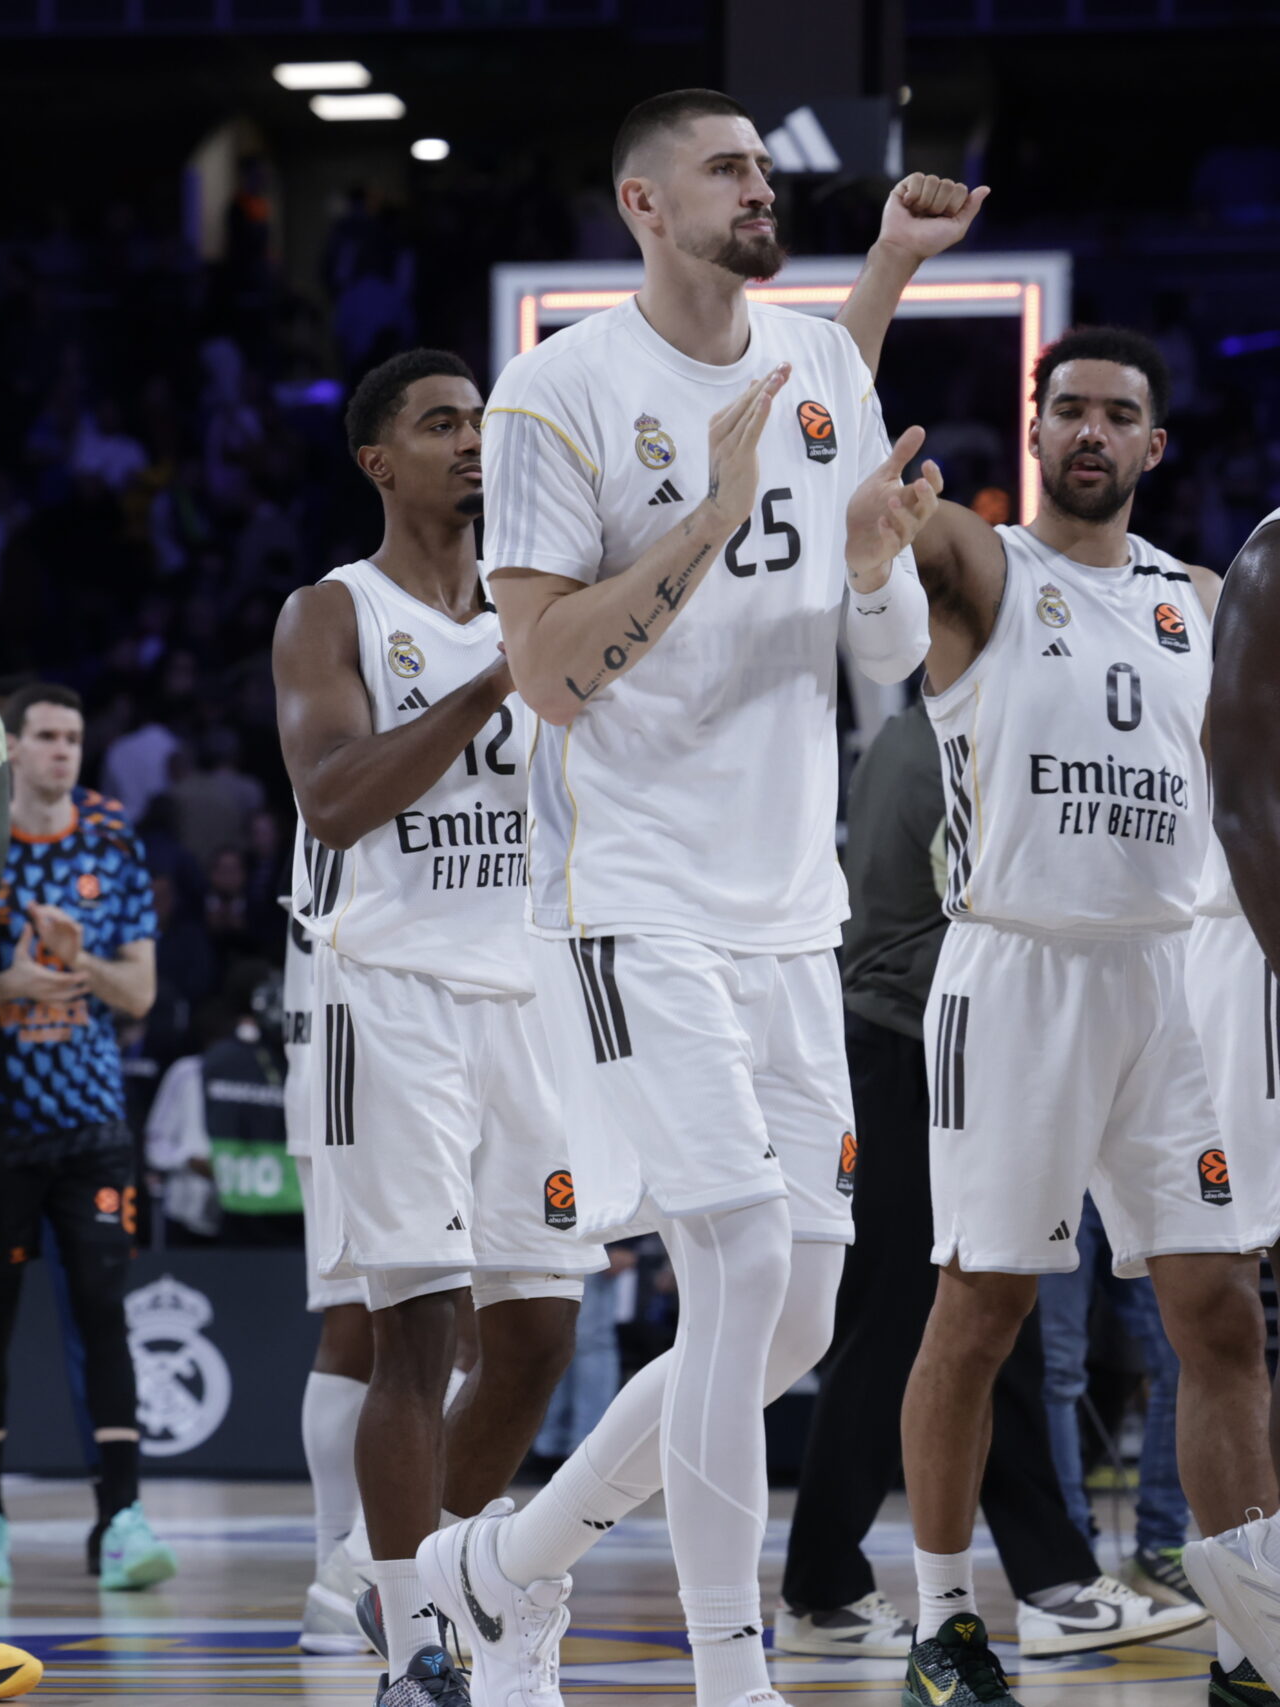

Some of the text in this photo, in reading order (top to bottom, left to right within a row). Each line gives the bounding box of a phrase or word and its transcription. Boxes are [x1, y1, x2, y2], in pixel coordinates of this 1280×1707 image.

[725, 487, 801, 578] 25
[1106, 662, 1142, 732] 0
[395, 801, 528, 854] Emira
[1058, 801, 1177, 846] FLY BETTER
[432, 854, 471, 890] FLY
